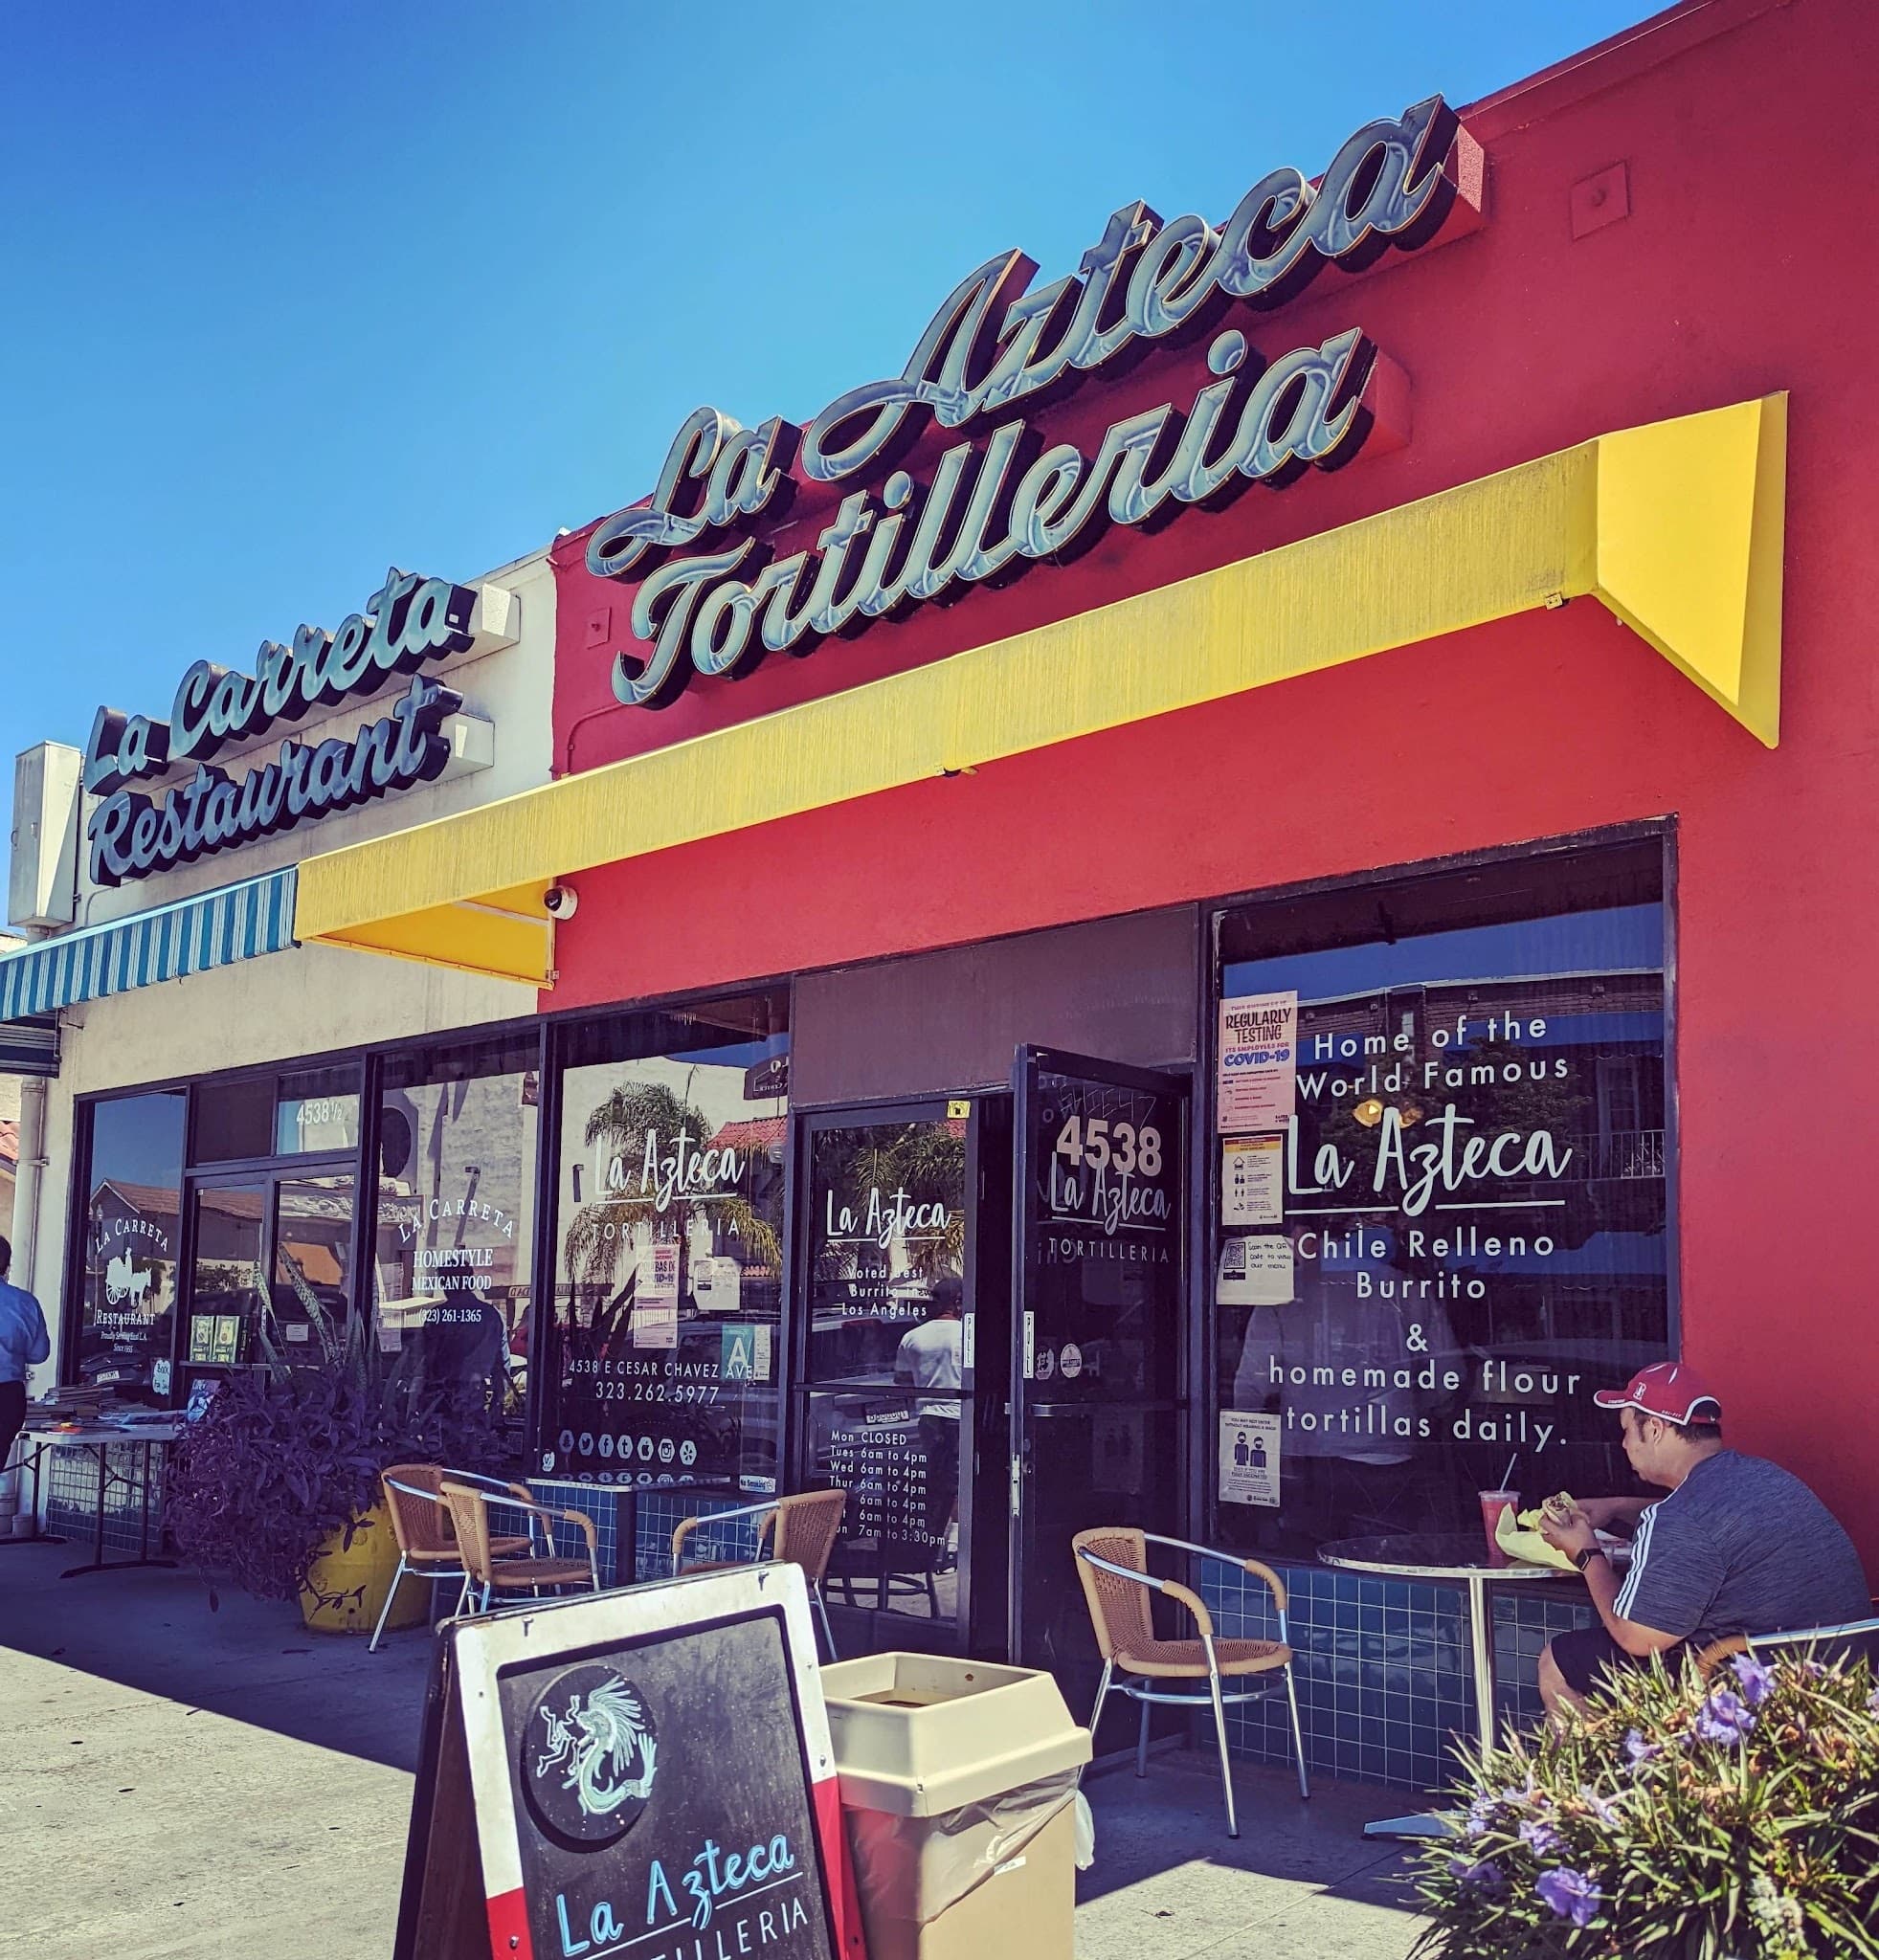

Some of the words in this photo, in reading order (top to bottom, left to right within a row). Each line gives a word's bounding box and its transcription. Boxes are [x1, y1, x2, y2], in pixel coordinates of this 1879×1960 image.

[585, 407, 797, 577] La
[802, 93, 1458, 482] Azteca
[612, 327, 1374, 708] Tortilleria
[84, 705, 168, 795] La
[168, 567, 475, 760] Carreta
[88, 673, 454, 885] Restaurant
[1225, 1008, 1291, 1030] REGULARLY
[1235, 1024, 1282, 1044] TESTING
[1313, 1032, 1411, 1059] Home
[1432, 1015, 1468, 1048] of
[1488, 1011, 1547, 1042] the
[1224, 1049, 1290, 1067] COVID-19
[1297, 1064, 1402, 1100] World
[1423, 1058, 1569, 1091] Famous
[296, 1102, 329, 1125] 4538
[1056, 1115, 1162, 1177] 4538
[594, 1133, 632, 1195] La
[640, 1126, 746, 1213] Azteca
[1286, 1114, 1354, 1196] La
[1373, 1102, 1573, 1217] Azteca
[1051, 1150, 1084, 1212] La
[1092, 1162, 1171, 1236] Azteca
[398, 1215, 422, 1243] LA
[430, 1199, 513, 1238] CARRETA
[593, 1217, 740, 1241] TORTILLERIA
[827, 1190, 859, 1236] La
[865, 1186, 951, 1250] Azteca
[96, 1232, 110, 1254] LA
[115, 1218, 168, 1252] CARRETA
[1297, 1231, 1387, 1259] Chile
[1409, 1226, 1555, 1258] Relleno
[414, 1249, 493, 1268] HOMESTYLE
[1048, 1237, 1170, 1263] TORTILLERIA
[412, 1276, 460, 1291] MEXICAN
[462, 1275, 492, 1290] FOOD
[847, 1264, 886, 1279] Voted
[850, 1283, 898, 1298] Burrito
[1356, 1271, 1487, 1300] Burrito
[96, 1308, 156, 1325] RESTAURANT
[418, 1308, 440, 1325] (323)
[442, 1308, 482, 1323] 261-1365
[841, 1303, 863, 1316] Los
[870, 1302, 927, 1320] Angeles
[1406, 1324, 1429, 1352] &
[727, 1337, 749, 1368] A
[569, 1359, 598, 1374] 4538
[604, 1360, 612, 1374] E
[617, 1361, 658, 1376] CESAR
[664, 1362, 719, 1379] CHAVEZ
[726, 1364, 753, 1379] AVE
[1269, 1355, 1460, 1392] homemade
[1481, 1360, 1580, 1396] flour
[595, 1381, 720, 1405] 323.262.5977
[831, 1430, 854, 1442] Mon
[861, 1432, 907, 1445] CLOSED
[1286, 1406, 1431, 1438] tortillas
[1452, 1408, 1568, 1453] daily.
[831, 1445, 854, 1458] Tues
[861, 1447, 884, 1460] 6am
[887, 1450, 899, 1461] to
[904, 1451, 928, 1465] 4pm
[830, 1460, 854, 1473] Wed
[861, 1462, 884, 1475] 6am
[887, 1465, 899, 1477] to
[903, 1467, 927, 1481] 4pm
[829, 1475, 854, 1488] Thur
[860, 1479, 883, 1491] 6am
[887, 1481, 899, 1493] to
[903, 1482, 927, 1497] 4pm
[860, 1494, 883, 1506] 6am
[886, 1497, 898, 1508] to
[903, 1498, 927, 1512] 4pm
[860, 1509, 882, 1523] 6am
[886, 1512, 898, 1524] to
[902, 1514, 926, 1528] 4pm
[836, 1526, 848, 1534] un
[858, 1524, 882, 1538] 7am
[886, 1527, 898, 1540] to
[902, 1529, 946, 1548] 3:30pm
[556, 1894, 623, 1957] La
[646, 1835, 794, 1930] Azteca
